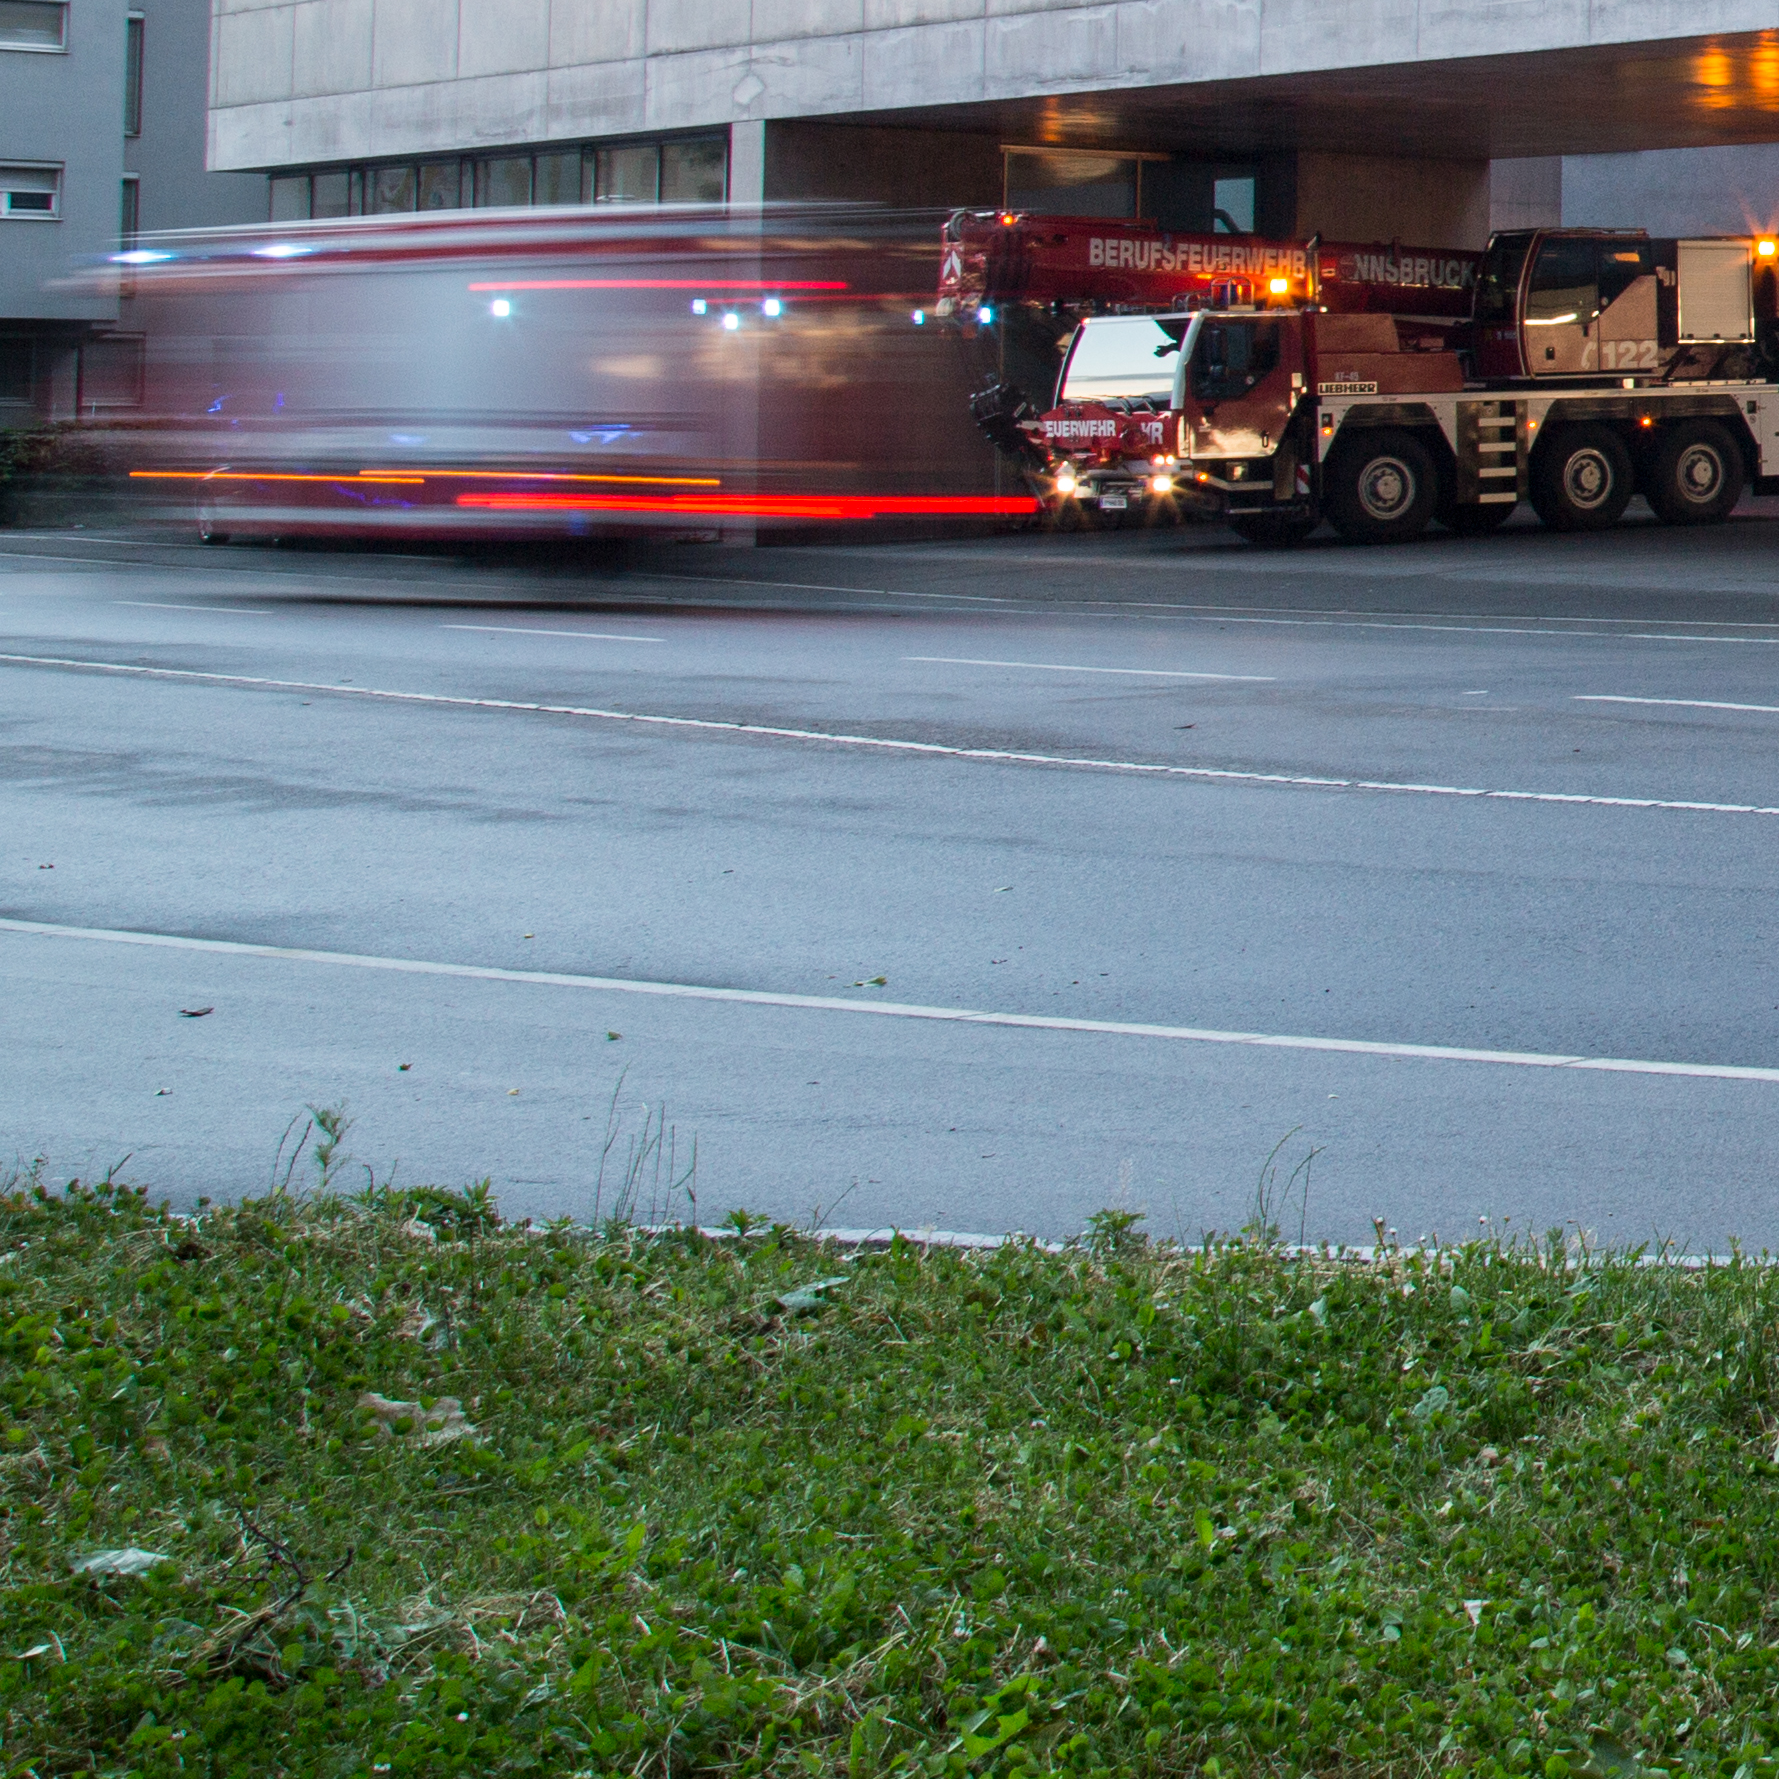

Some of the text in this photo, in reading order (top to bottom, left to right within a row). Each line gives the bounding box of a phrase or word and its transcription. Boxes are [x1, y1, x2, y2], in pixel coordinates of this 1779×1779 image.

[1089, 237, 1478, 286] BERUFSFEUERWEHR NNSBRUCK
[1602, 340, 1658, 369] 122
[1319, 383, 1375, 393] LIEBHERR
[1045, 420, 1116, 437] EUERWEHR
